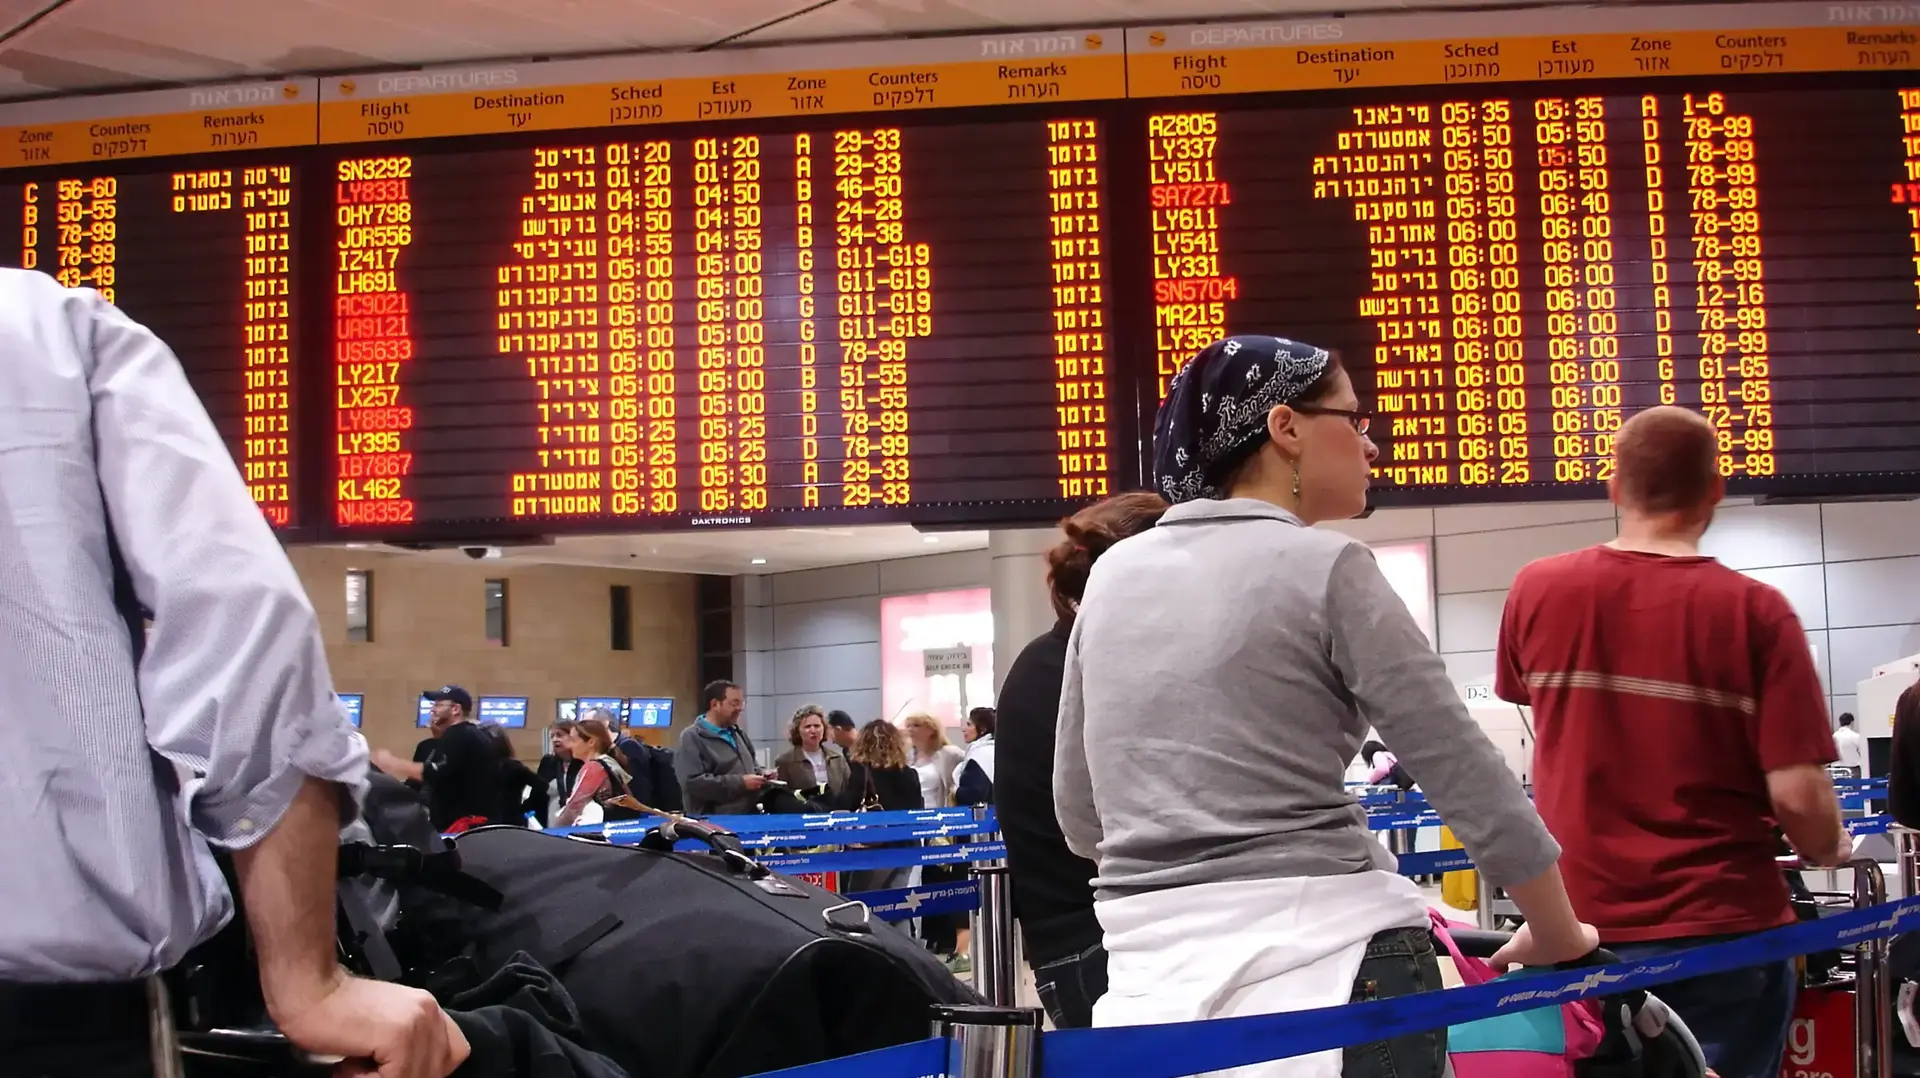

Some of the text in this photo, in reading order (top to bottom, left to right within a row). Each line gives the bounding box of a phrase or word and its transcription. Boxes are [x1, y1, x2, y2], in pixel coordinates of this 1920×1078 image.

[980, 34, 1076, 57] המראות
[1190, 23, 1344, 46] DEPARTURES
[1630, 37, 1672, 52] Zone
[1715, 33, 1788, 49] Counters
[1846, 29, 1918, 46] Remarks
[1296, 46, 1395, 65] Destination
[1444, 41, 1500, 60] Sched
[1551, 39, 1578, 55] Est
[1858, 49, 1911, 66] הערות
[998, 62, 1067, 80] Remarks
[1173, 54, 1228, 73] Flight
[1444, 61, 1501, 82] מתוכנן
[1537, 58, 1595, 78] מעודכן
[1634, 56, 1670, 72] אזור
[1720, 51, 1785, 71] דלפקים
[378, 68, 518, 94] DEPARTURES
[787, 76, 827, 91] Zone
[868, 70, 939, 87] Counters
[1181, 73, 1221, 91] טיסה
[1333, 67, 1360, 84] יעד
[189, 85, 275, 108] המראות
[611, 84, 663, 102] Sched
[712, 80, 736, 96] Est
[873, 87, 935, 108] דלפקים
[1007, 81, 1060, 99] הערות
[361, 101, 411, 121] Flight
[473, 91, 565, 111] Destination
[698, 98, 753, 119] מעודכן
[790, 94, 824, 111] אזור
[1441, 100, 1510, 125] 05:35
[1534, 97, 1604, 121] 05:35
[1641, 95, 1657, 117] A
[1682, 93, 1723, 116] 1-6
[203, 112, 265, 129] Remarks
[506, 112, 533, 128] יעד
[609, 104, 663, 124] מתוכנן
[1148, 113, 1217, 138] AZ805
[18, 129, 54, 144] Zone
[89, 122, 151, 139] Counters
[210, 129, 258, 147] הערות
[367, 119, 404, 136] טיסה
[1442, 124, 1511, 148] 05:50
[1643, 119, 1658, 141] D
[1682, 116, 1752, 139] 78-99
[91, 138, 148, 158] דלפקים
[796, 133, 811, 156] A
[834, 128, 901, 153] 29-33
[1149, 136, 1217, 161] LY337
[20, 146, 50, 161] אזור
[606, 141, 671, 166] 01:20
[244, 166, 291, 186] טיסה
[338, 156, 412, 182] SN3292
[695, 159, 760, 184] 01:20
[1150, 160, 1216, 185] LY511
[24, 182, 39, 204] C
[57, 177, 117, 201] 56-60
[243, 187, 290, 208] עליה
[338, 179, 409, 202] LY8331
[797, 179, 812, 202] B
[836, 174, 902, 199] 46-50
[1152, 183, 1230, 206] SA7271
[57, 199, 117, 223] 50-55
[607, 187, 672, 211] 04:50
[836, 198, 903, 223] 24-28
[1540, 192, 1609, 216] 06:40
[24, 204, 38, 226] B
[338, 202, 412, 227] OHY798
[695, 205, 761, 230] 04:50
[1152, 207, 1218, 232] LY611
[1689, 211, 1759, 235] 78-99
[24, 226, 38, 248] D
[57, 221, 116, 245] 78-99
[337, 224, 412, 249] JOR556
[836, 221, 903, 246] 34-38
[1153, 230, 1219, 255] LY541
[1447, 219, 1517, 243] 06:00
[57, 243, 116, 267] 78-99
[608, 233, 673, 257] 04:55
[837, 245, 930, 269] G11-G19
[23, 248, 37, 269] D
[339, 247, 400, 272] IZ417
[608, 256, 673, 280] 05:00
[798, 249, 813, 271] G
[1154, 254, 1220, 279] LY331
[57, 264, 115, 288] 43-49
[337, 270, 397, 295] LH691
[696, 275, 762, 299] 05:00
[1155, 277, 1236, 301] SN5704
[1696, 283, 1764, 307] 12-16
[338, 294, 409, 317] AC9021
[608, 303, 674, 327] 05:00
[838, 292, 931, 316] G11-G19
[1156, 302, 1225, 327] MA215
[1451, 291, 1521, 315] 06:00
[338, 317, 409, 340] UA9121
[338, 339, 413, 362] US5633
[609, 349, 675, 373] 05:00
[801, 342, 816, 366] D
[839, 339, 906, 364] 78-99
[337, 362, 400, 386] LY217
[840, 363, 907, 387] 51-55
[1455, 363, 1525, 388] 06:00
[1699, 355, 1769, 379] G1-G5
[698, 369, 765, 393] 05:00
[338, 385, 400, 409] LX257
[1551, 383, 1621, 409] 06:00
[338, 408, 413, 431] LY8853
[699, 416, 766, 440] 05:25
[1702, 405, 1772, 428] 72-75
[338, 431, 400, 455] LY395
[610, 419, 676, 444] 05:25
[842, 434, 909, 459] 78-99
[1458, 436, 1528, 461] 06:05
[338, 454, 413, 477] IB7867
[1459, 460, 1530, 485] 06:25
[338, 477, 401, 501] KL462
[611, 466, 677, 491] 05:30
[612, 490, 677, 514] 05:30
[701, 487, 767, 511] 05:30
[842, 482, 910, 506] 29-33
[338, 500, 413, 523] NW8352
[691, 516, 752, 526] DAKTRONICS
[1467, 687, 1488, 700] D-2
